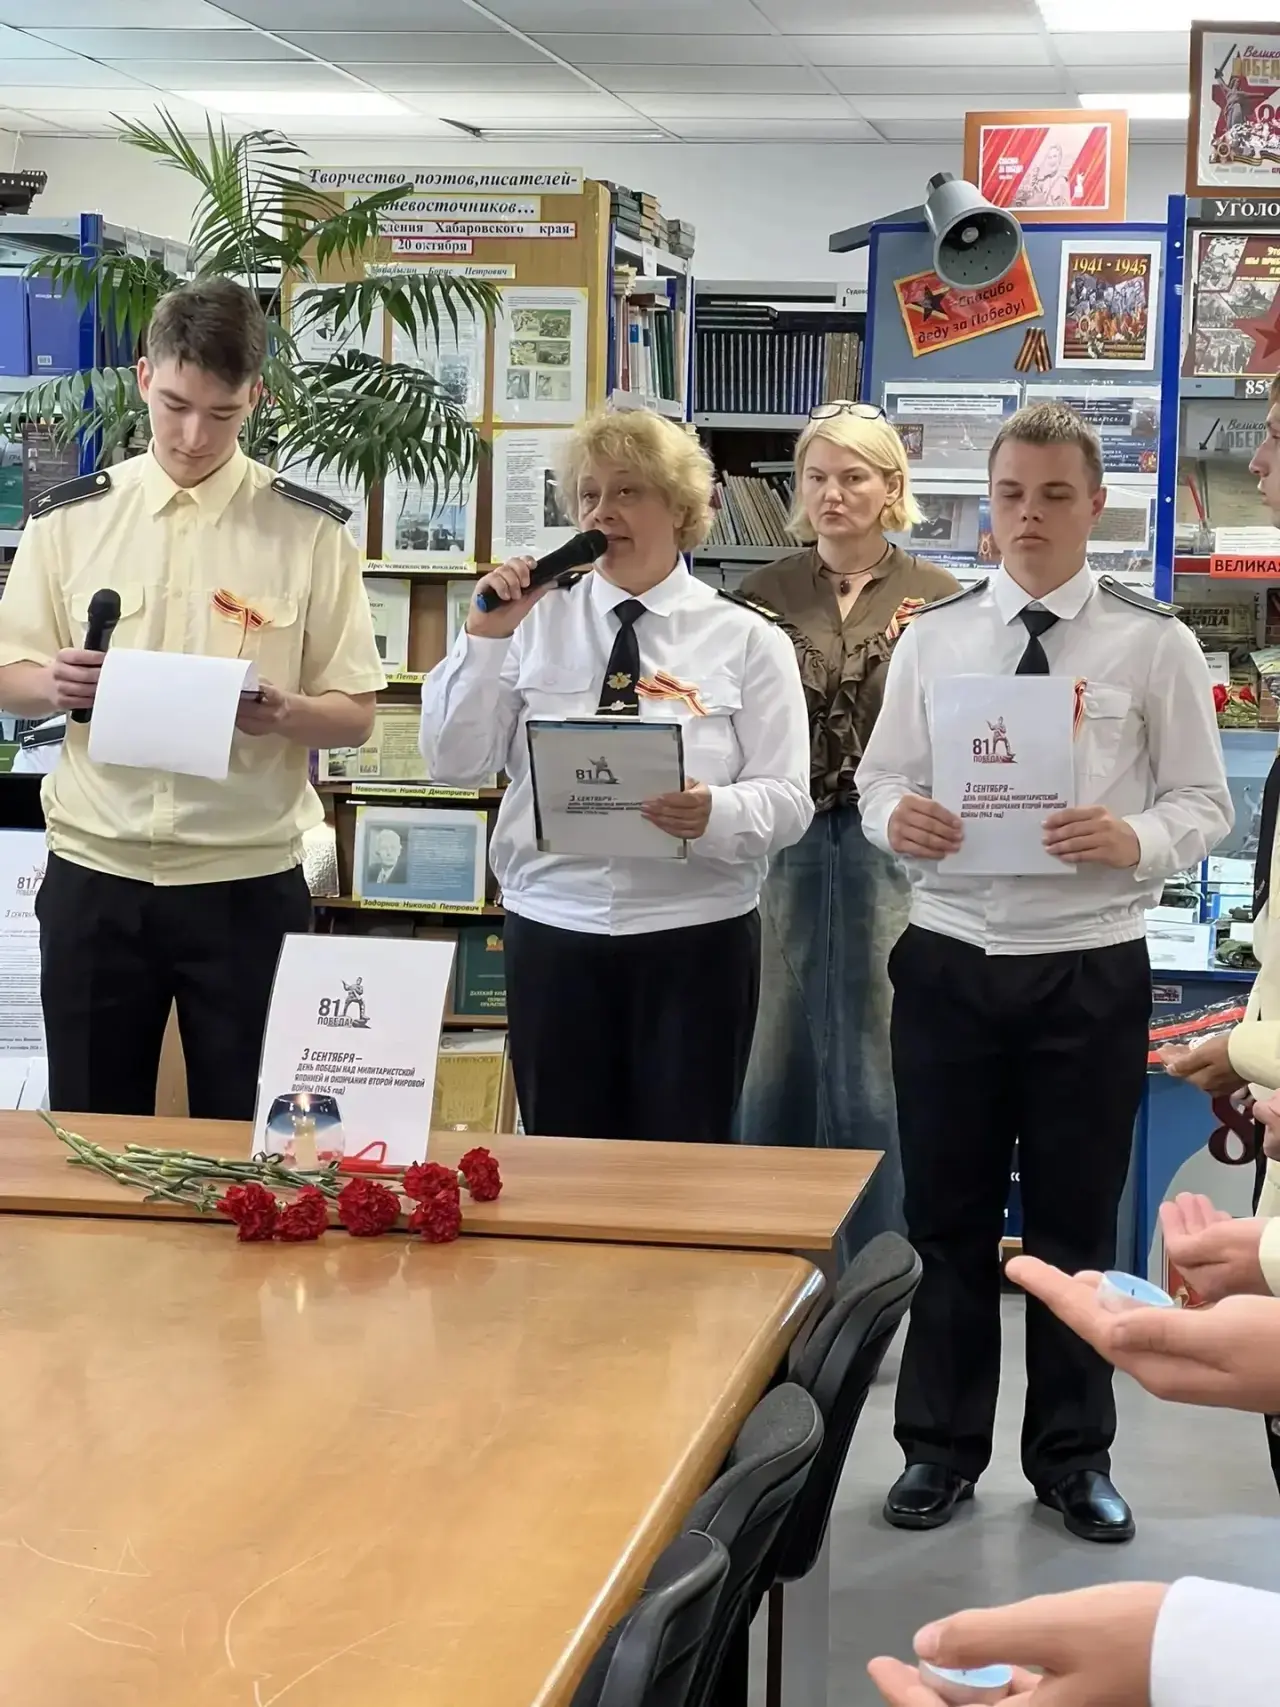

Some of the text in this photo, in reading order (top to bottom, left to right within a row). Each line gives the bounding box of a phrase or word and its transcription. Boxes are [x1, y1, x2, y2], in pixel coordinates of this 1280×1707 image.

[309, 169, 406, 187] Творчество
[436, 222, 524, 236] Хабаровского
[398, 239, 467, 255] 20 октября
[428, 265, 454, 276] Борис
[464, 267, 508, 276] Петрович
[1073, 258, 1103, 274] 1941
[1114, 258, 1147, 275] 1945
[957, 281, 1015, 307] Спасибо
[918, 298, 1026, 344] деду за Победу!
[973, 738, 989, 755] 81
[576, 769, 593, 780] 81
[965, 782, 972, 793] 3
[17, 876, 31, 889] 81
[363, 899, 480, 912] Задорнов Николай Петрович
[318, 998, 341, 1017] 81
[301, 1048, 310, 1061] 3
[297, 1063, 415, 1077] ДЕНЬ ПОБЕДЫ НАД МИЛИТАРИСТСКОЙ
[295, 1073, 324, 1082] ЯПОНИЕЙ
[330, 1075, 367, 1085] ОКОНЧАНИЯ
[368, 1076, 393, 1086] ВТОРОЙ
[394, 1078, 425, 1088] МИРОВОЙ
[291, 1083, 346, 1095] ВОЙНЫ (1945 год)
